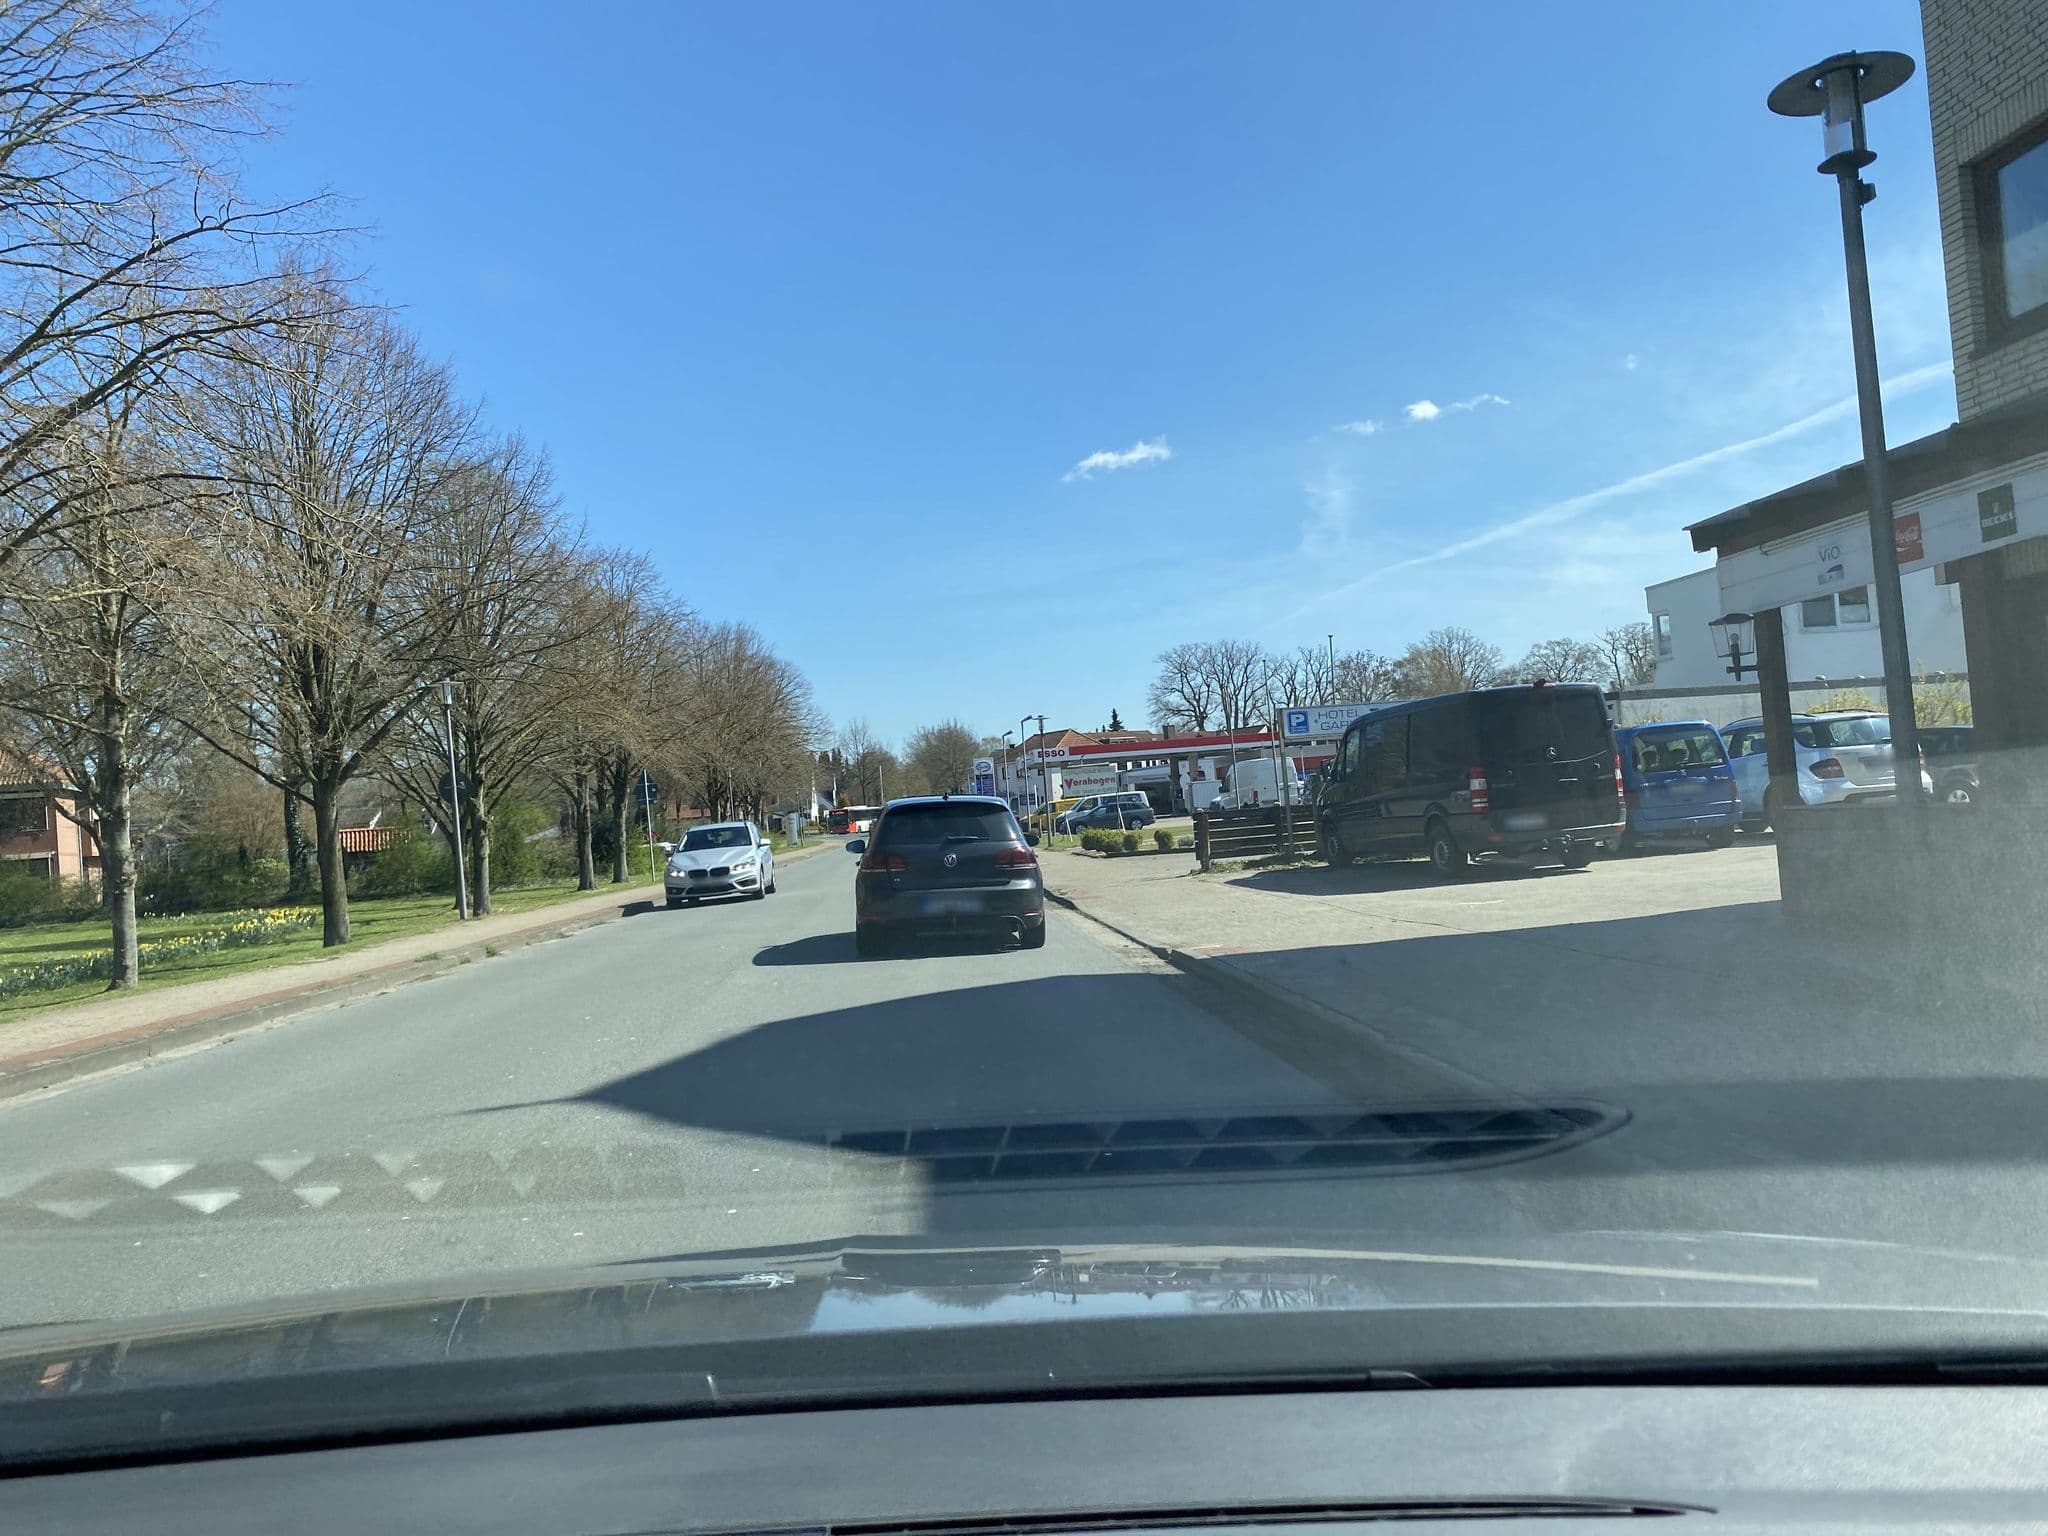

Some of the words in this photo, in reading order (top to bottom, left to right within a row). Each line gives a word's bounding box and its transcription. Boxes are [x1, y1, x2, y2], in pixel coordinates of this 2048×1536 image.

[1318, 709, 1359, 720] HOTEL
[1290, 713, 1305, 727] P
[1320, 721, 1353, 731] GAR
[1037, 749, 1065, 758] ESSO
